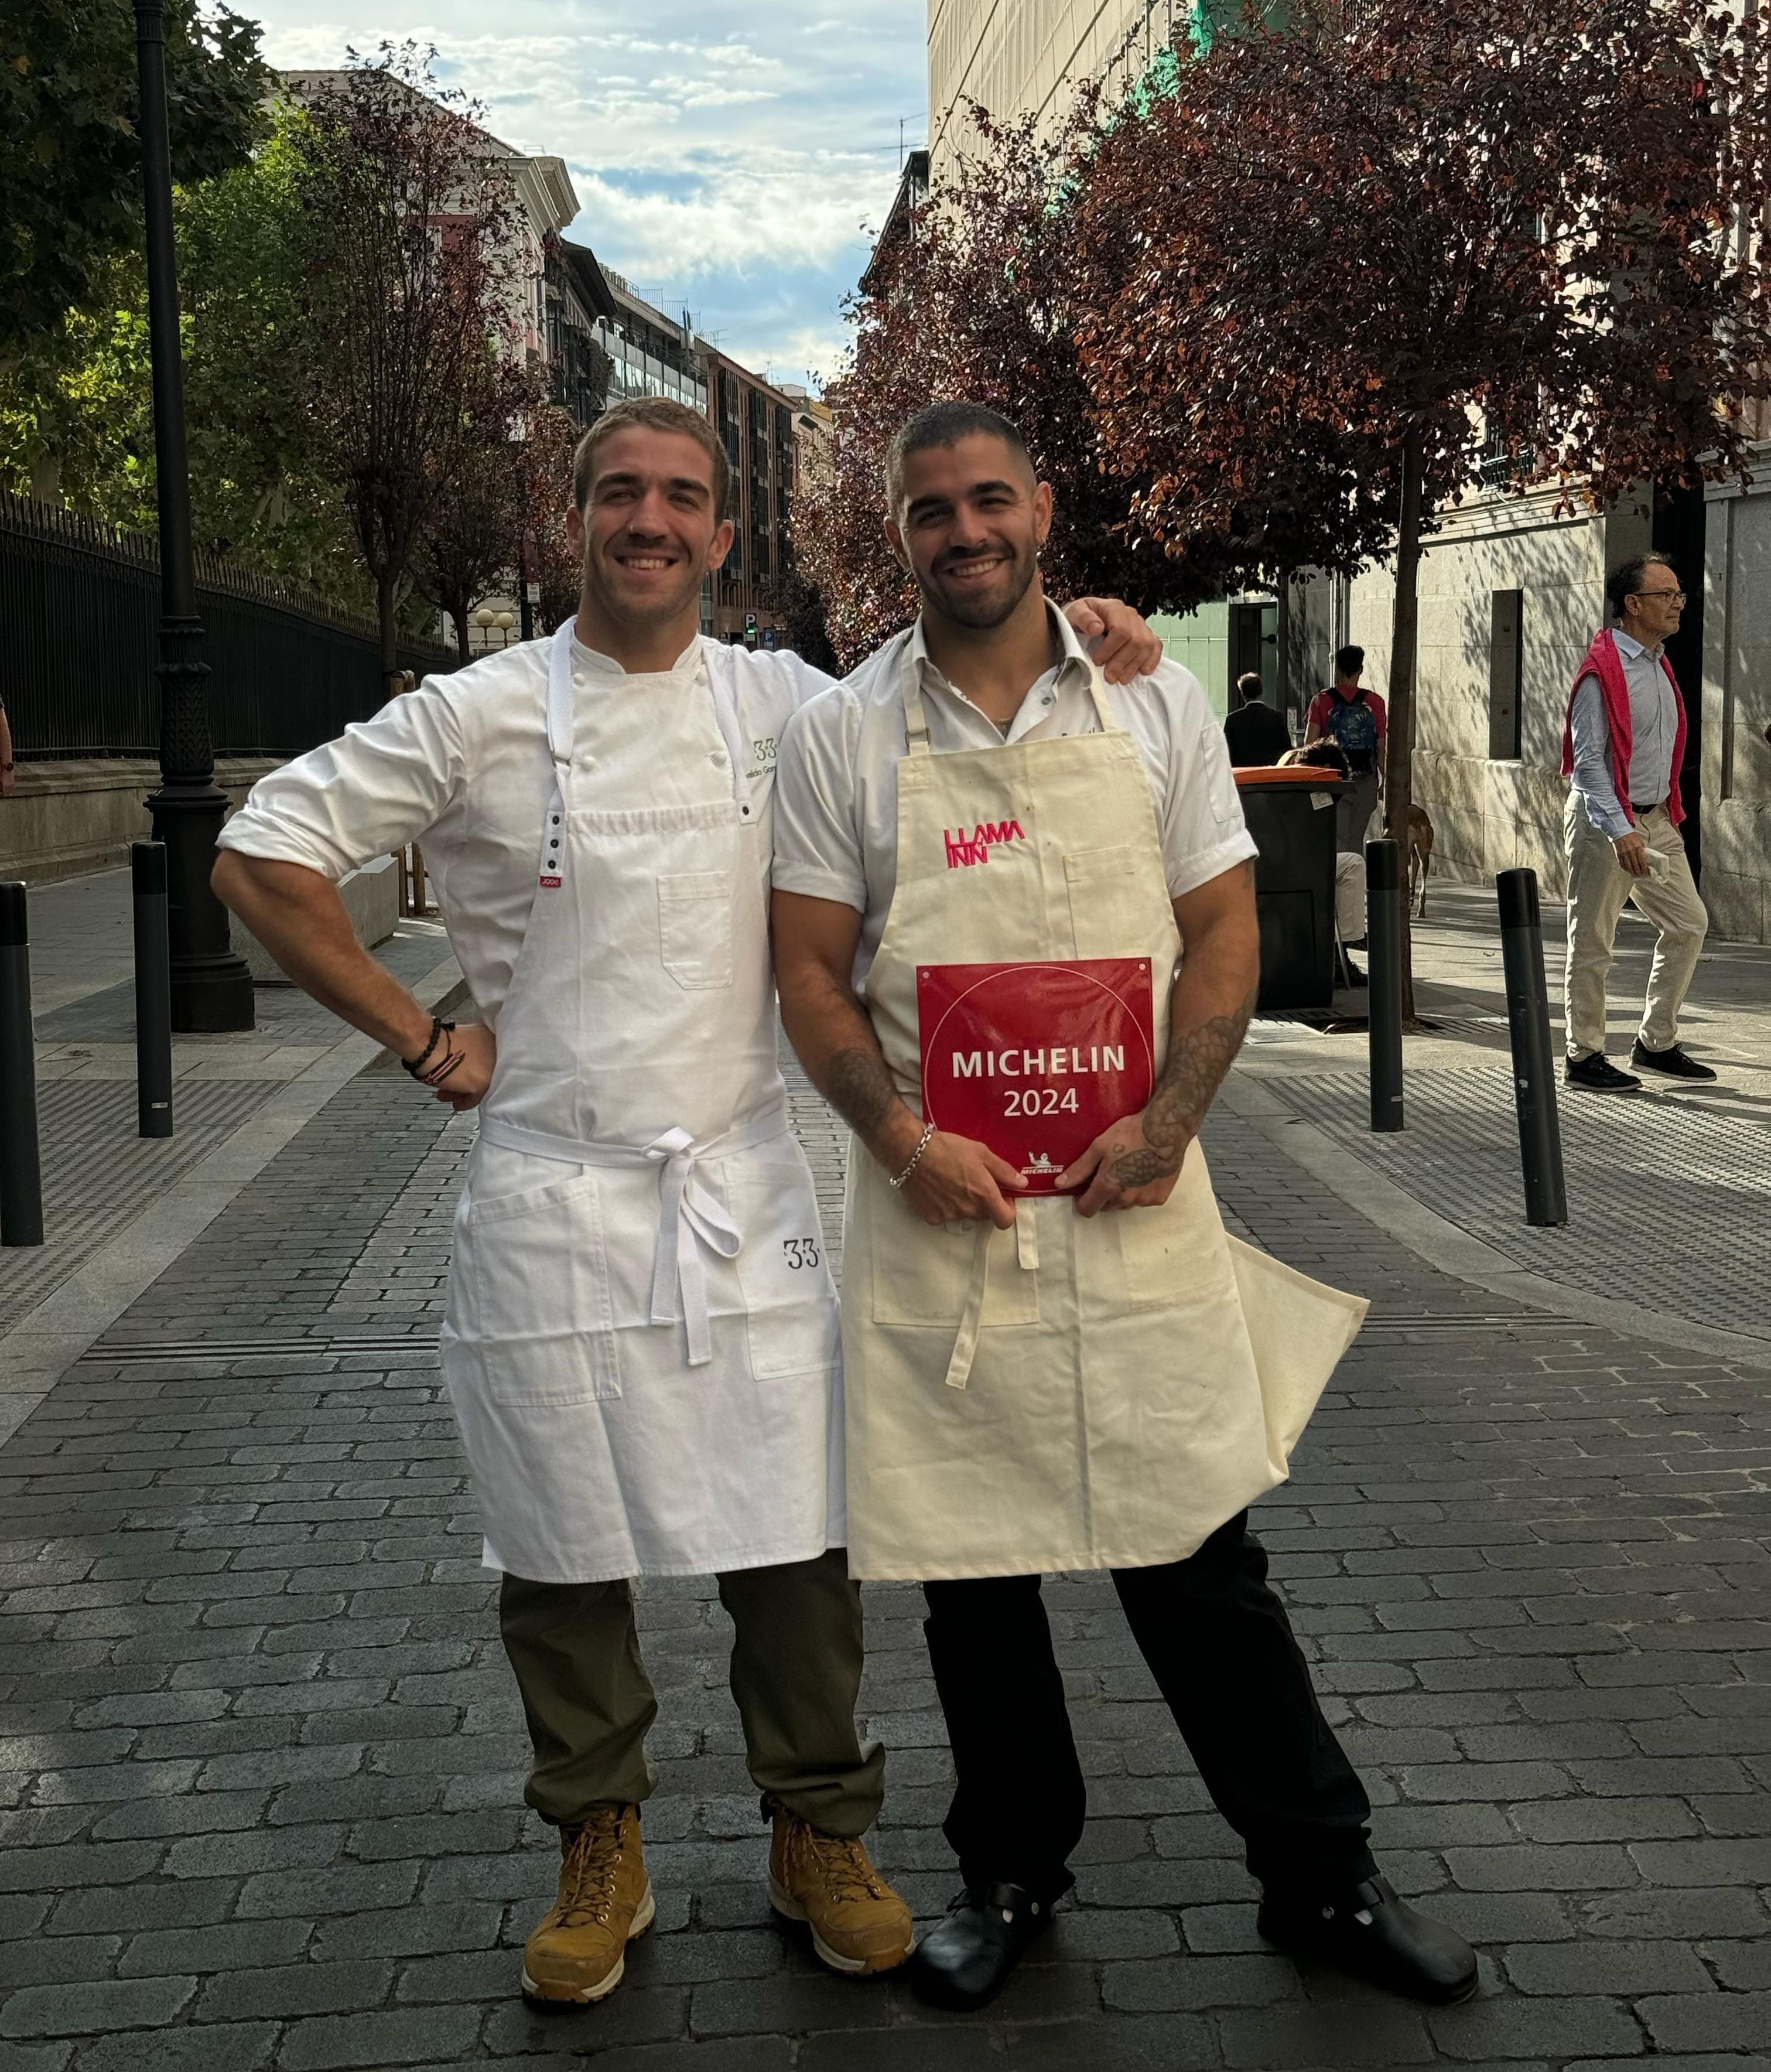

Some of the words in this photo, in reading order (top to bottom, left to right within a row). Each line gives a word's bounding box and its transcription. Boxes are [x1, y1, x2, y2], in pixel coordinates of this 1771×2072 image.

[746, 615, 755, 628] P
[944, 820, 1026, 848] LLAMA
[948, 845, 988, 869] INN
[952, 1045, 1125, 1078] MICHELIN
[1003, 1087, 1079, 1117] 2024
[1020, 1166, 1064, 1175] MICHELIN
